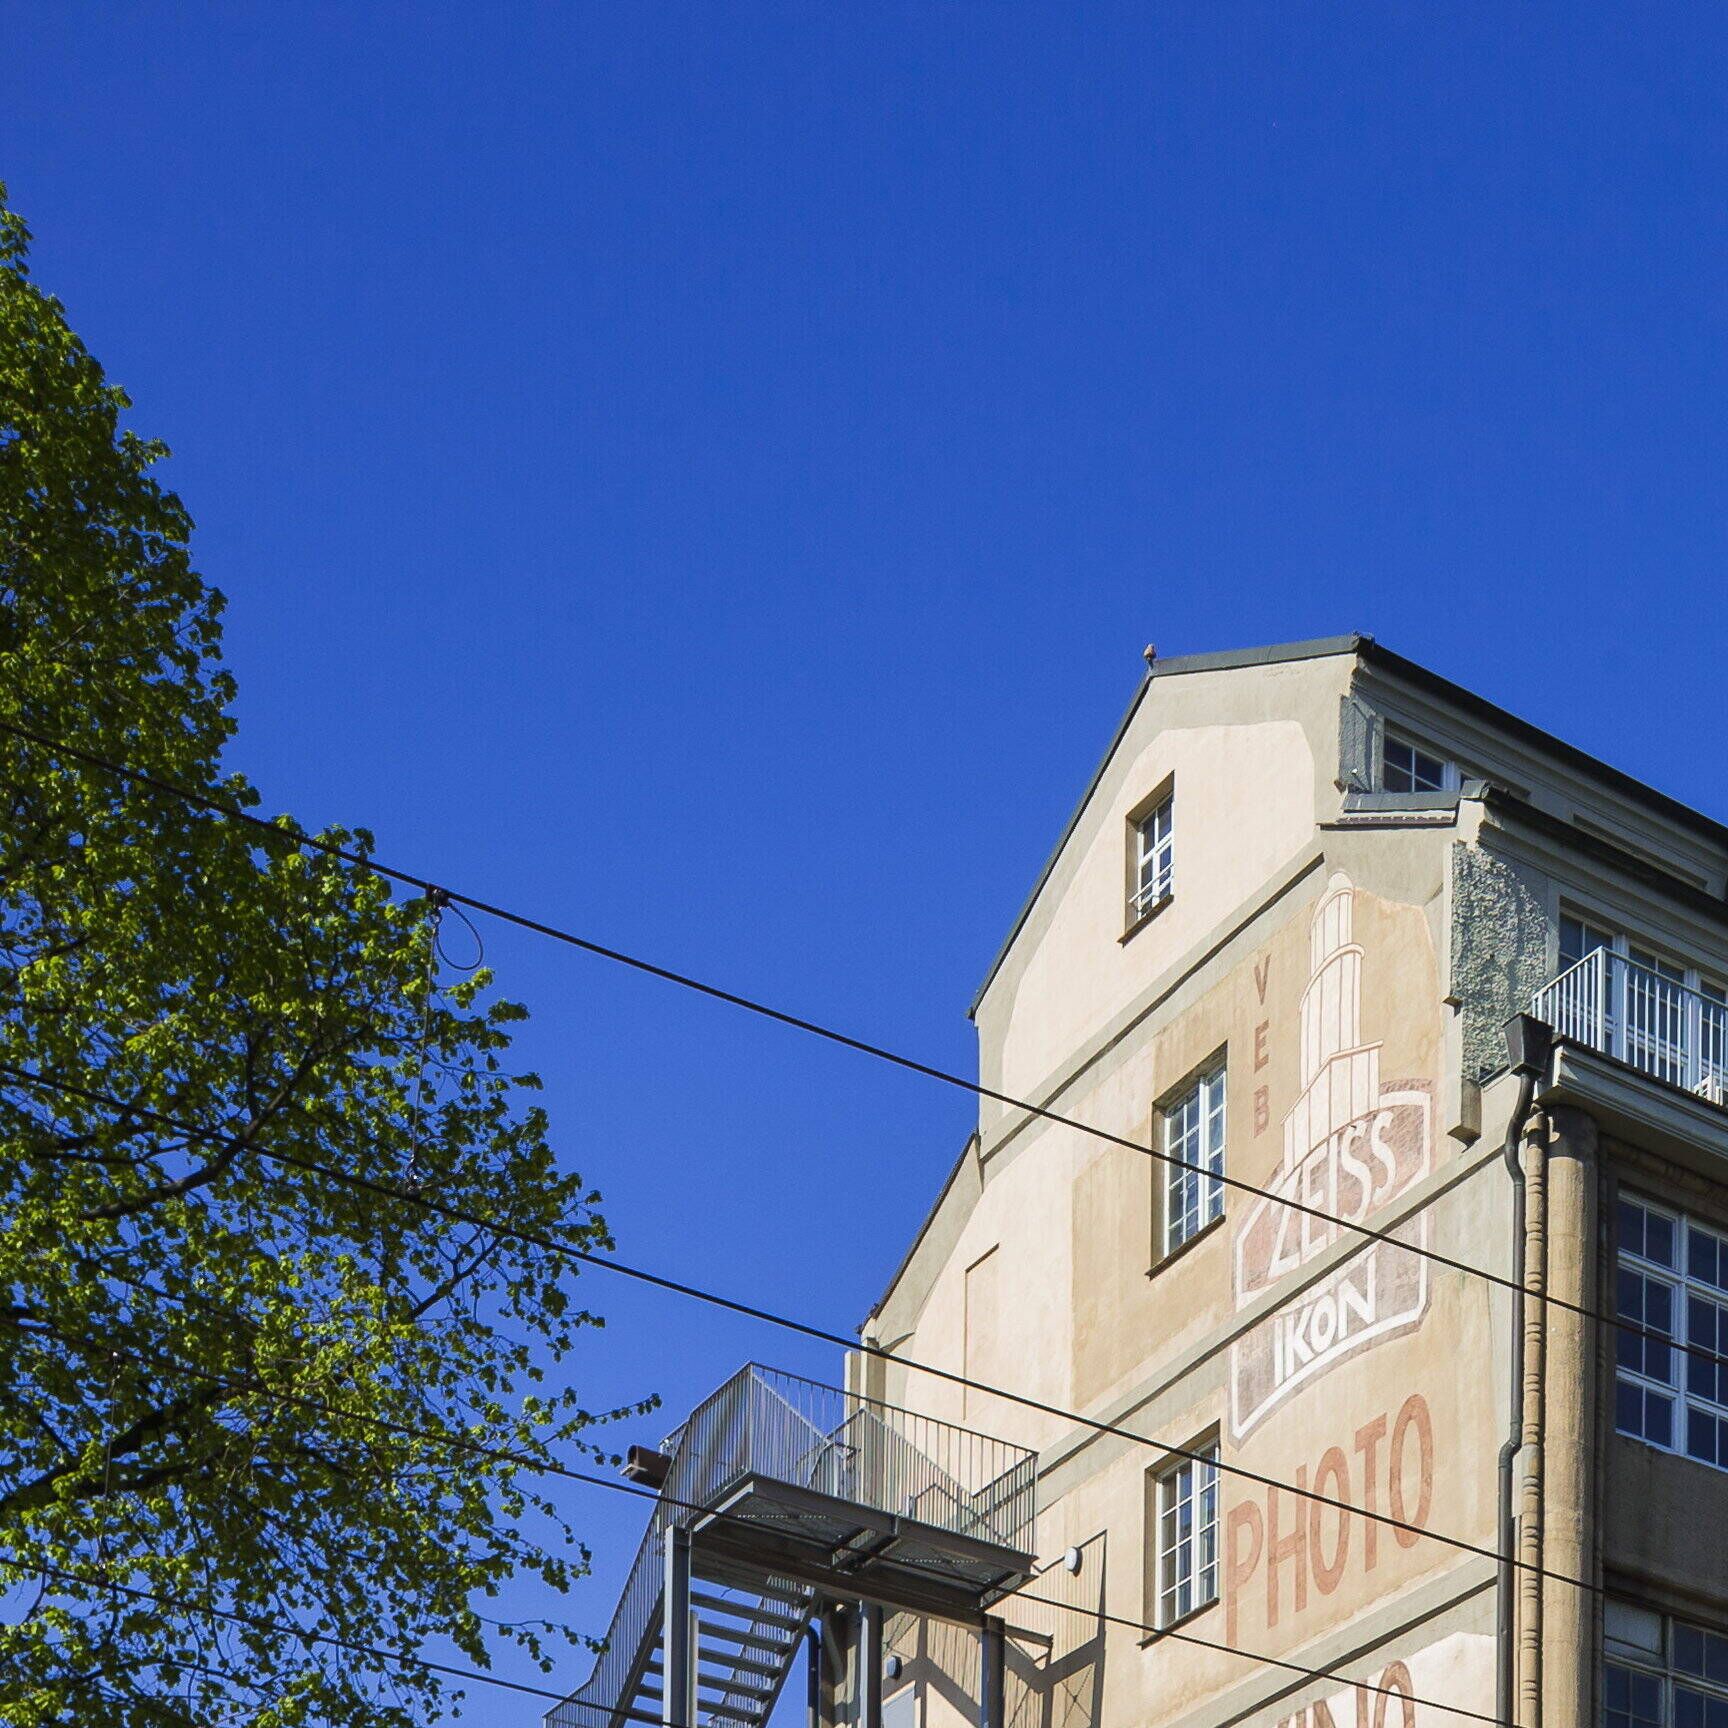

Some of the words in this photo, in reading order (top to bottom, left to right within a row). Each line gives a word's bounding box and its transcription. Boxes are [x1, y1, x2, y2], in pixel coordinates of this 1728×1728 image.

[1253, 954, 1270, 1138] VEB
[1268, 1110, 1397, 1280] ZEISS
[1274, 1253, 1377, 1387] IKON
[1226, 1393, 1434, 1648] PHOTO
